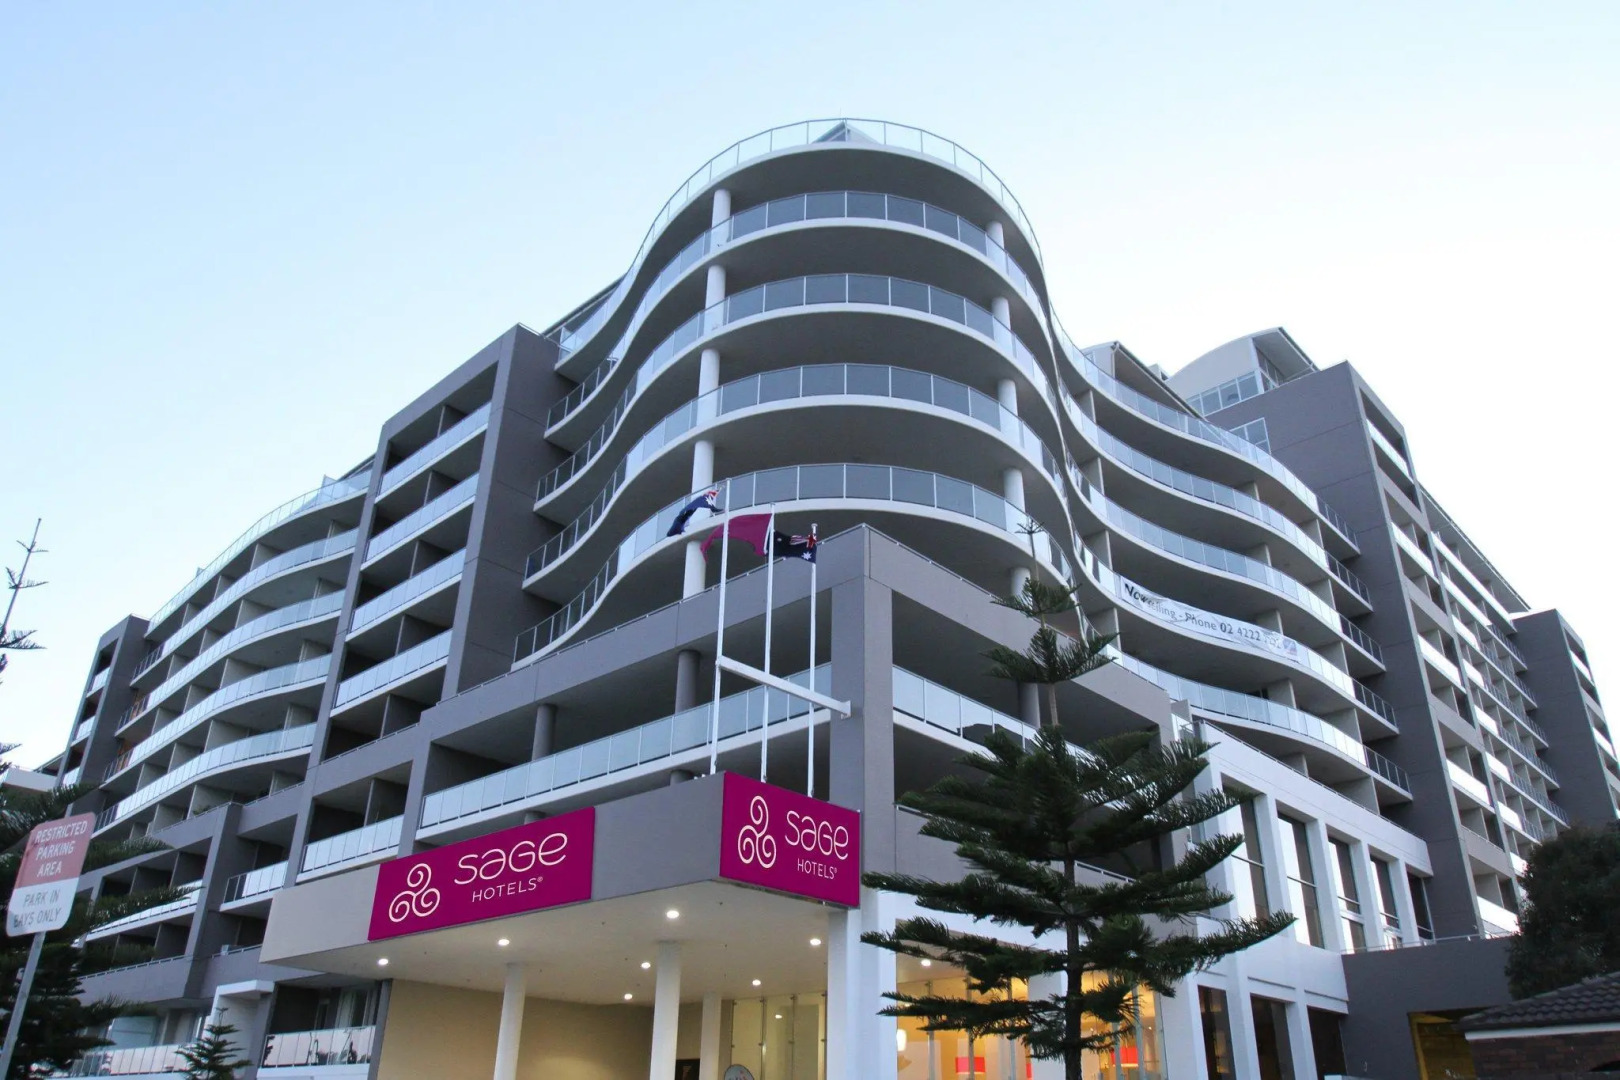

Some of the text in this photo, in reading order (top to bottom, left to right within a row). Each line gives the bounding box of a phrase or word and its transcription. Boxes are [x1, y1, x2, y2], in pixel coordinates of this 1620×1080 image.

[1125, 583, 1148, 603] Now
[1184, 611, 1218, 632] Phone
[1220, 622, 1234, 635] 02
[1237, 627, 1261, 642] 4222
[35, 821, 88, 843] RESTRICTED
[35, 840, 76, 861] PARKING
[36, 861, 62, 878] AREA
[23, 888, 61, 908] PARK IN
[36, 907, 62, 925] ONLY
